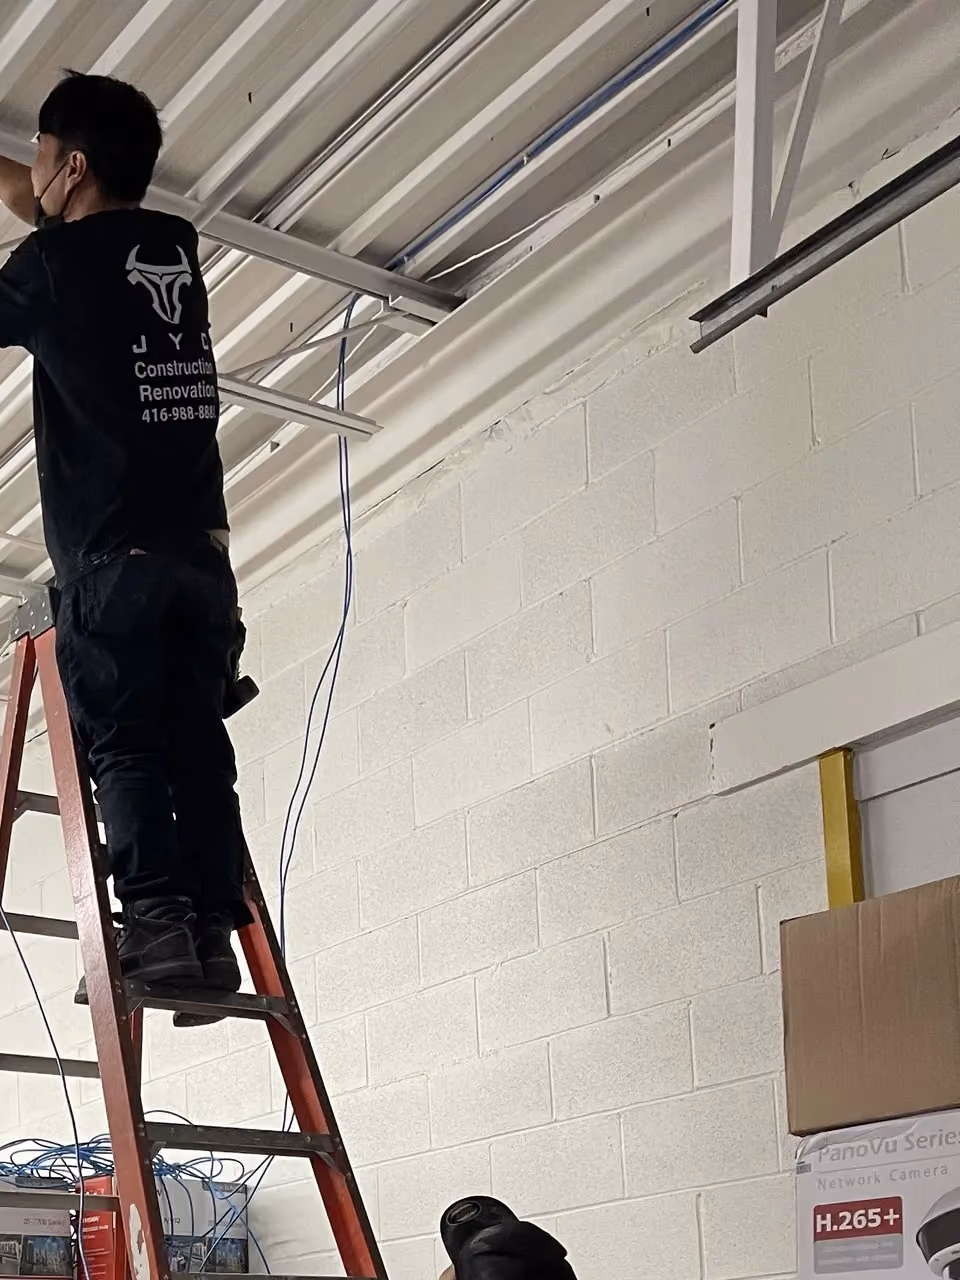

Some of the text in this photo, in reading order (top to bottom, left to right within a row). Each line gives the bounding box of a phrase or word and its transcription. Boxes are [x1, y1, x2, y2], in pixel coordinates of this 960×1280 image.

[132, 333, 183, 354] J Y
[135, 357, 214, 379] Construction
[139, 379, 216, 403] Renovation
[817, 1136, 898, 1164] PanoVu
[817, 1165, 949, 1191] Network Camera
[816, 1208, 900, 1233] H.265+
